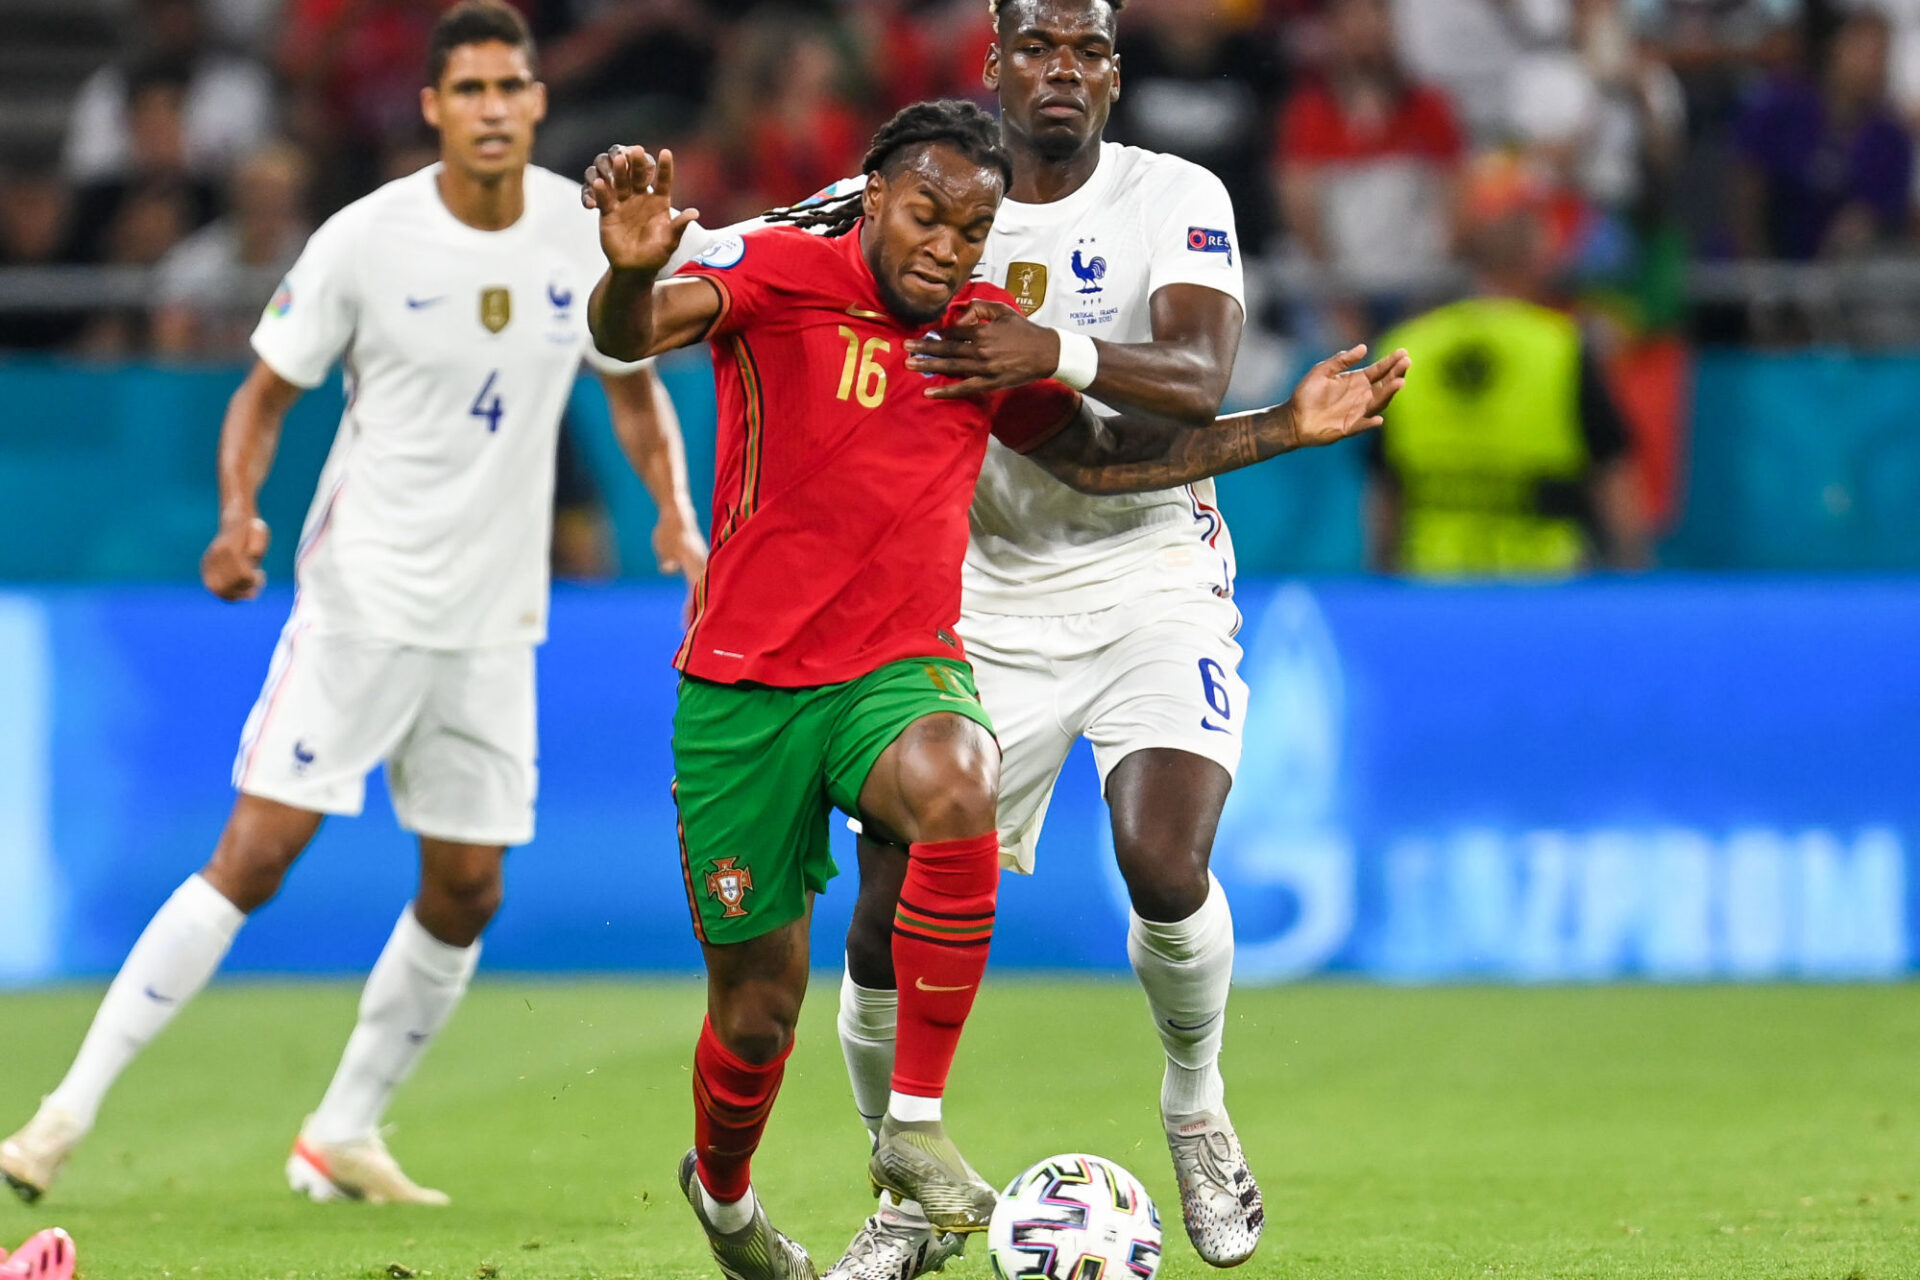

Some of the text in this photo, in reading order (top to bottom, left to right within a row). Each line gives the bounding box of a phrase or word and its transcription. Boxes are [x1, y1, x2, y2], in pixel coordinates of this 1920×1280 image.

[1015, 297, 1034, 305] FIFA
[836, 324, 891, 408] 16
[470, 367, 503, 433] 4
[1198, 657, 1231, 721] 6
